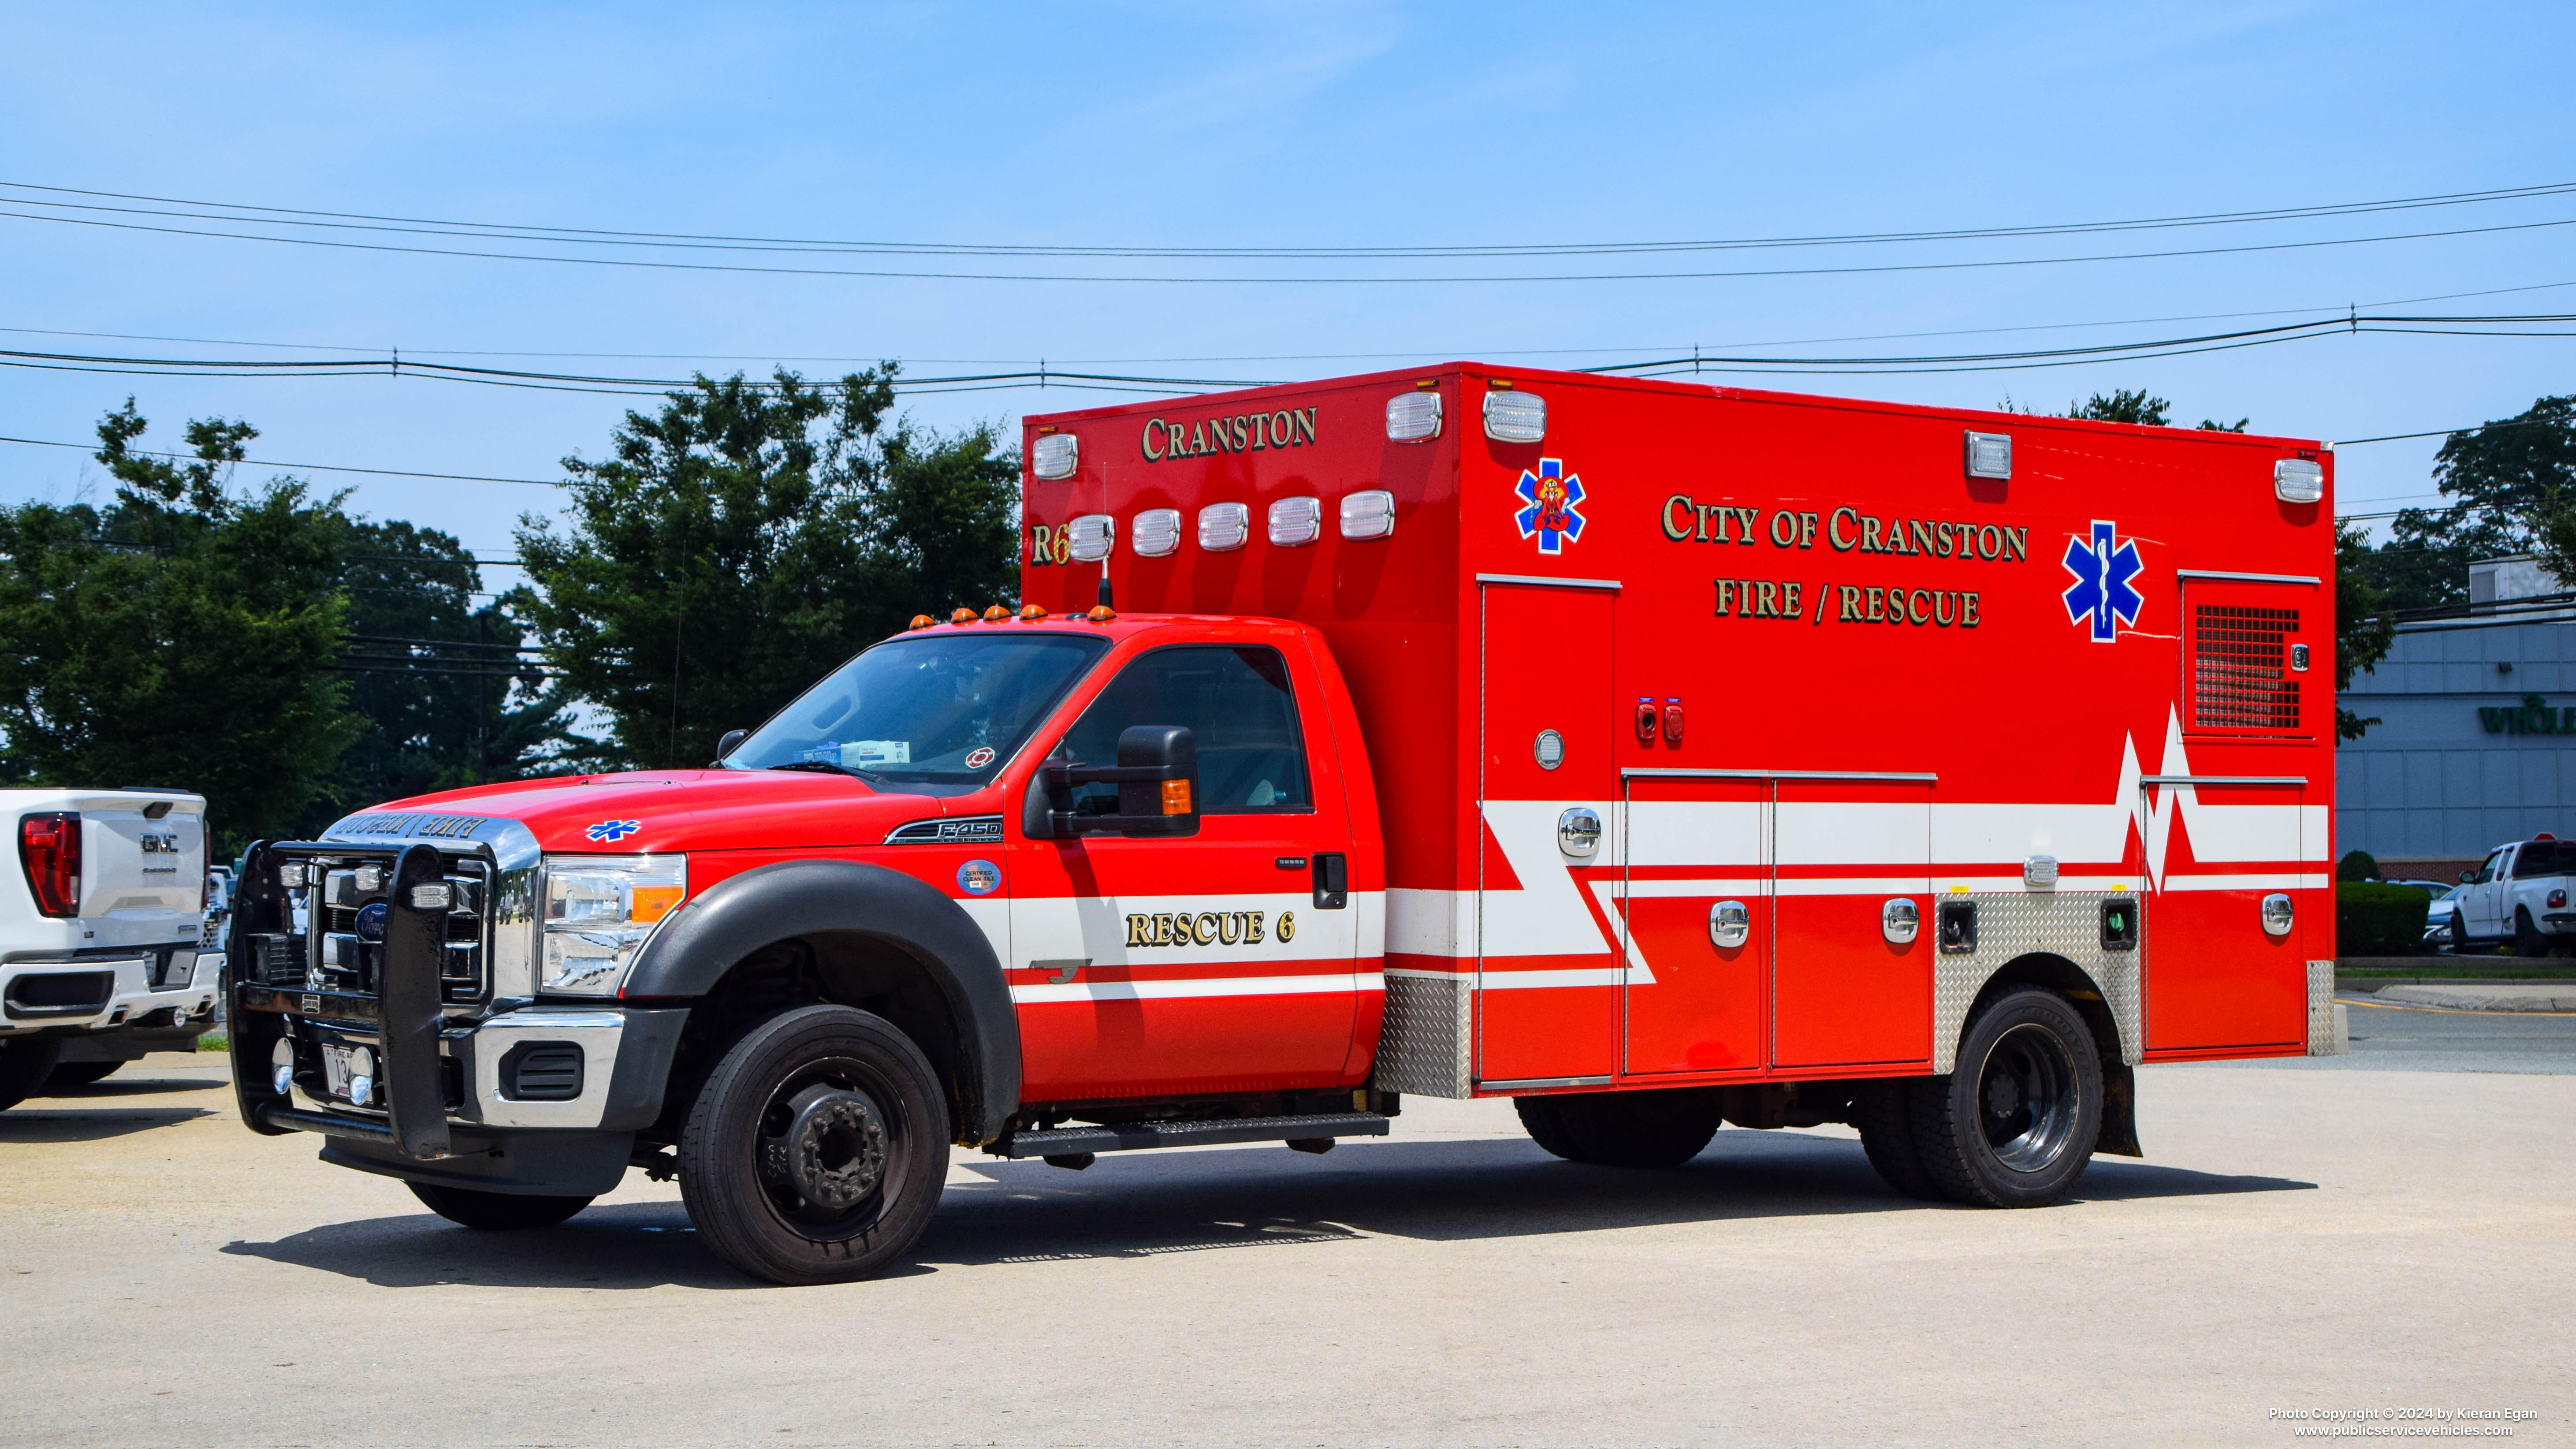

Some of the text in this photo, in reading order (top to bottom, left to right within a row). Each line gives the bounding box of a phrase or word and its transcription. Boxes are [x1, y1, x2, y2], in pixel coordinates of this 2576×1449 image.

[1141, 407, 1318, 462] CRANSTON
[1031, 523, 1069, 566] R6
[1661, 493, 2029, 563] CITY OF CRANSTON
[1714, 578, 1980, 628] FIRE / RESCUE
[141, 834, 179, 854] GMC
[938, 823, 1002, 837] F-450
[1125, 911, 1295, 947] RESCUE 6
[335, 1058, 349, 1084] 13
